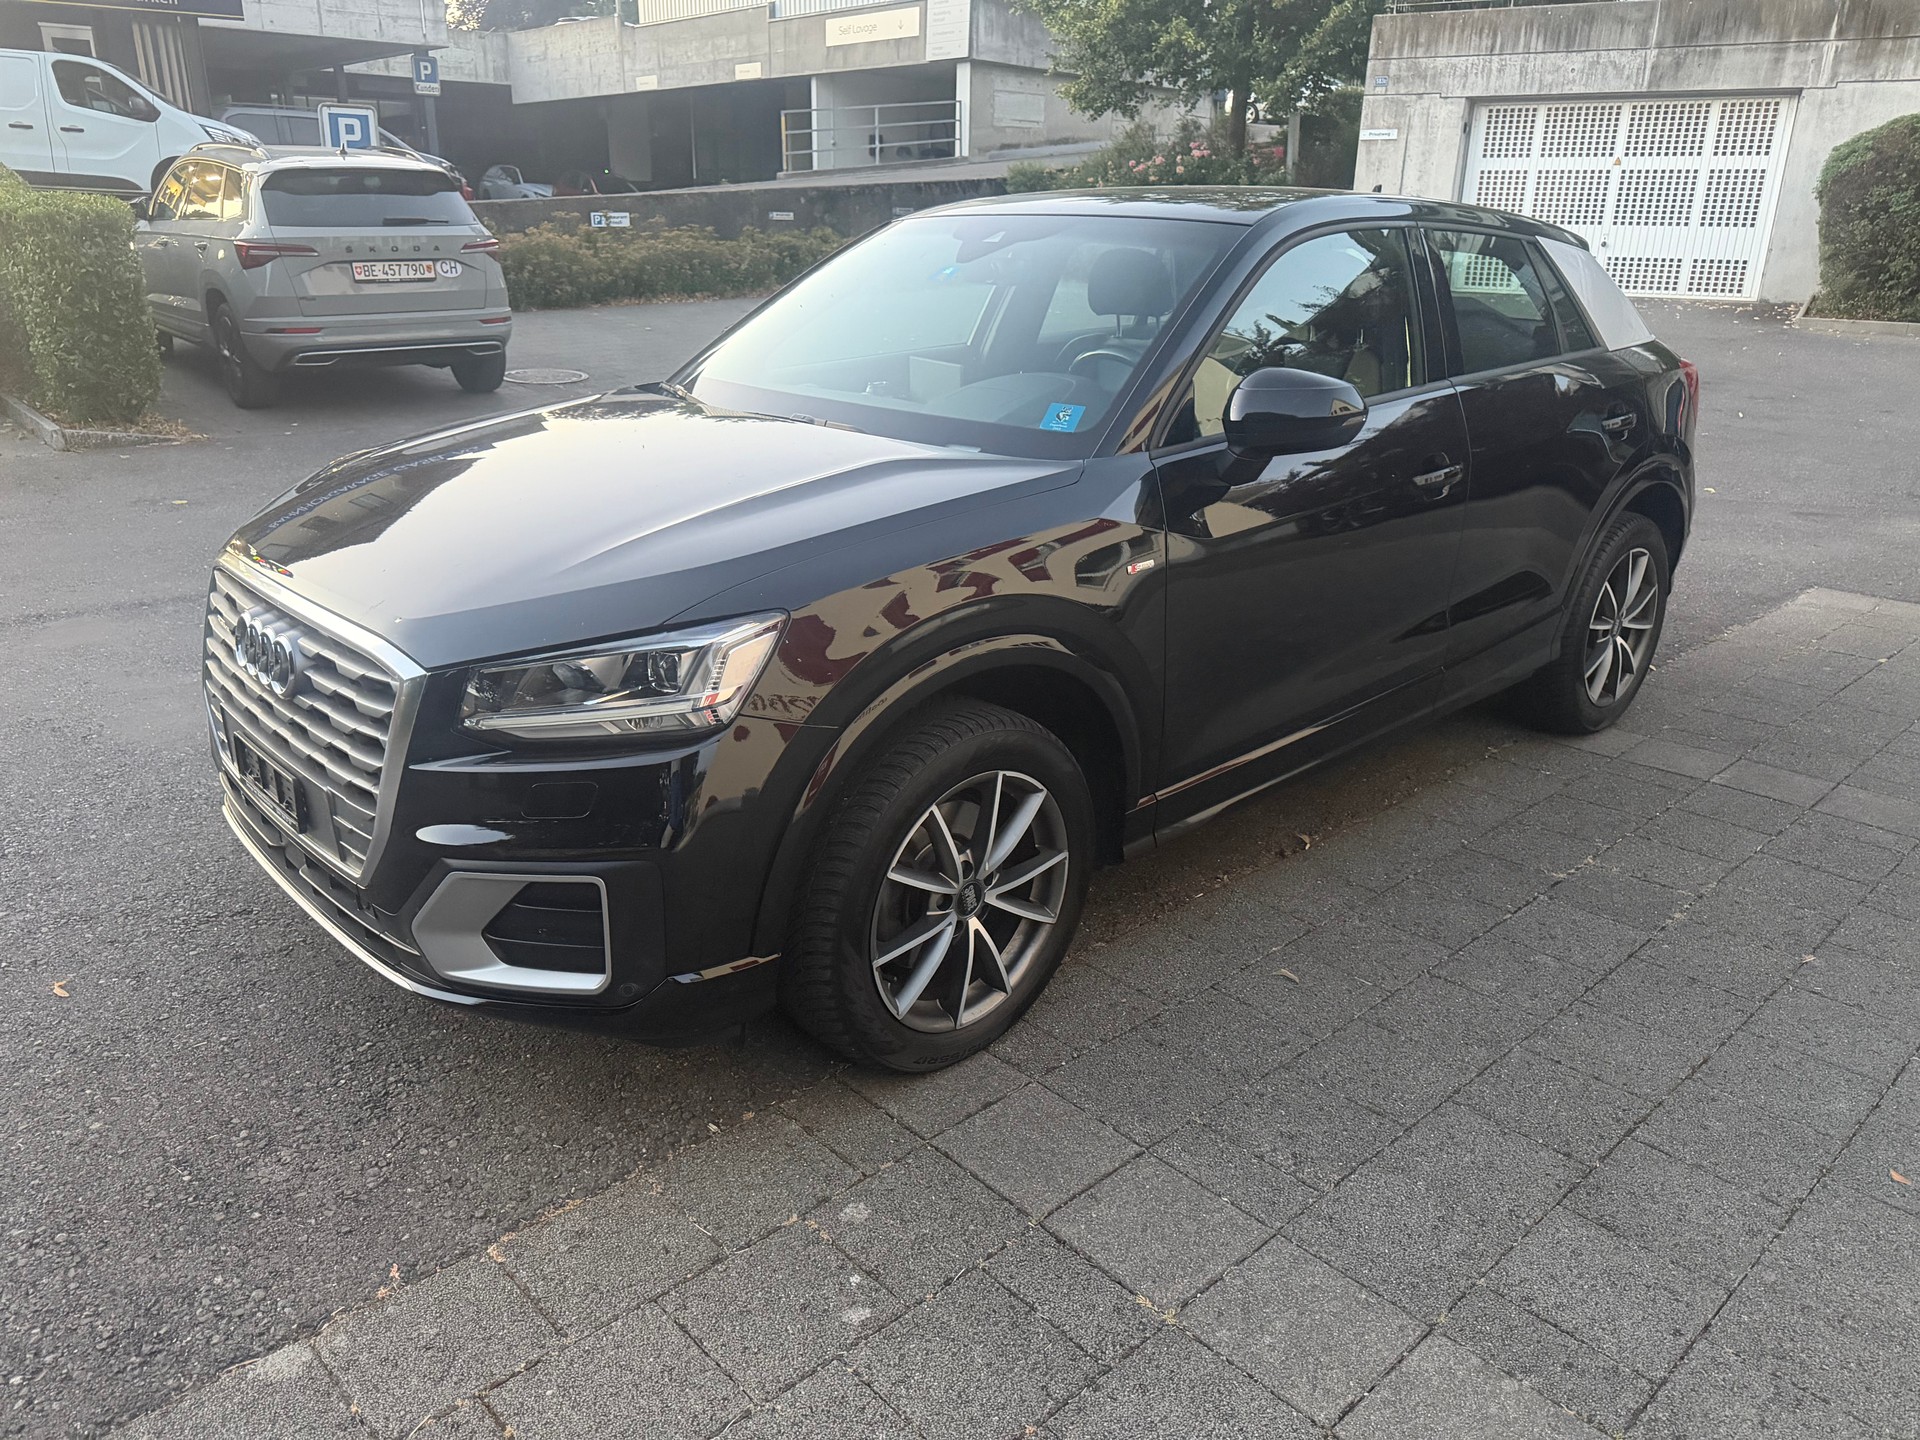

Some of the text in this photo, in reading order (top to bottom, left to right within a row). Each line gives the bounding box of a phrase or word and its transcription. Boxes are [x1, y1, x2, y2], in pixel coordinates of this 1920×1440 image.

[420, 62, 431, 80] P
[338, 117, 362, 149] P
[440, 261, 458, 275] CH
